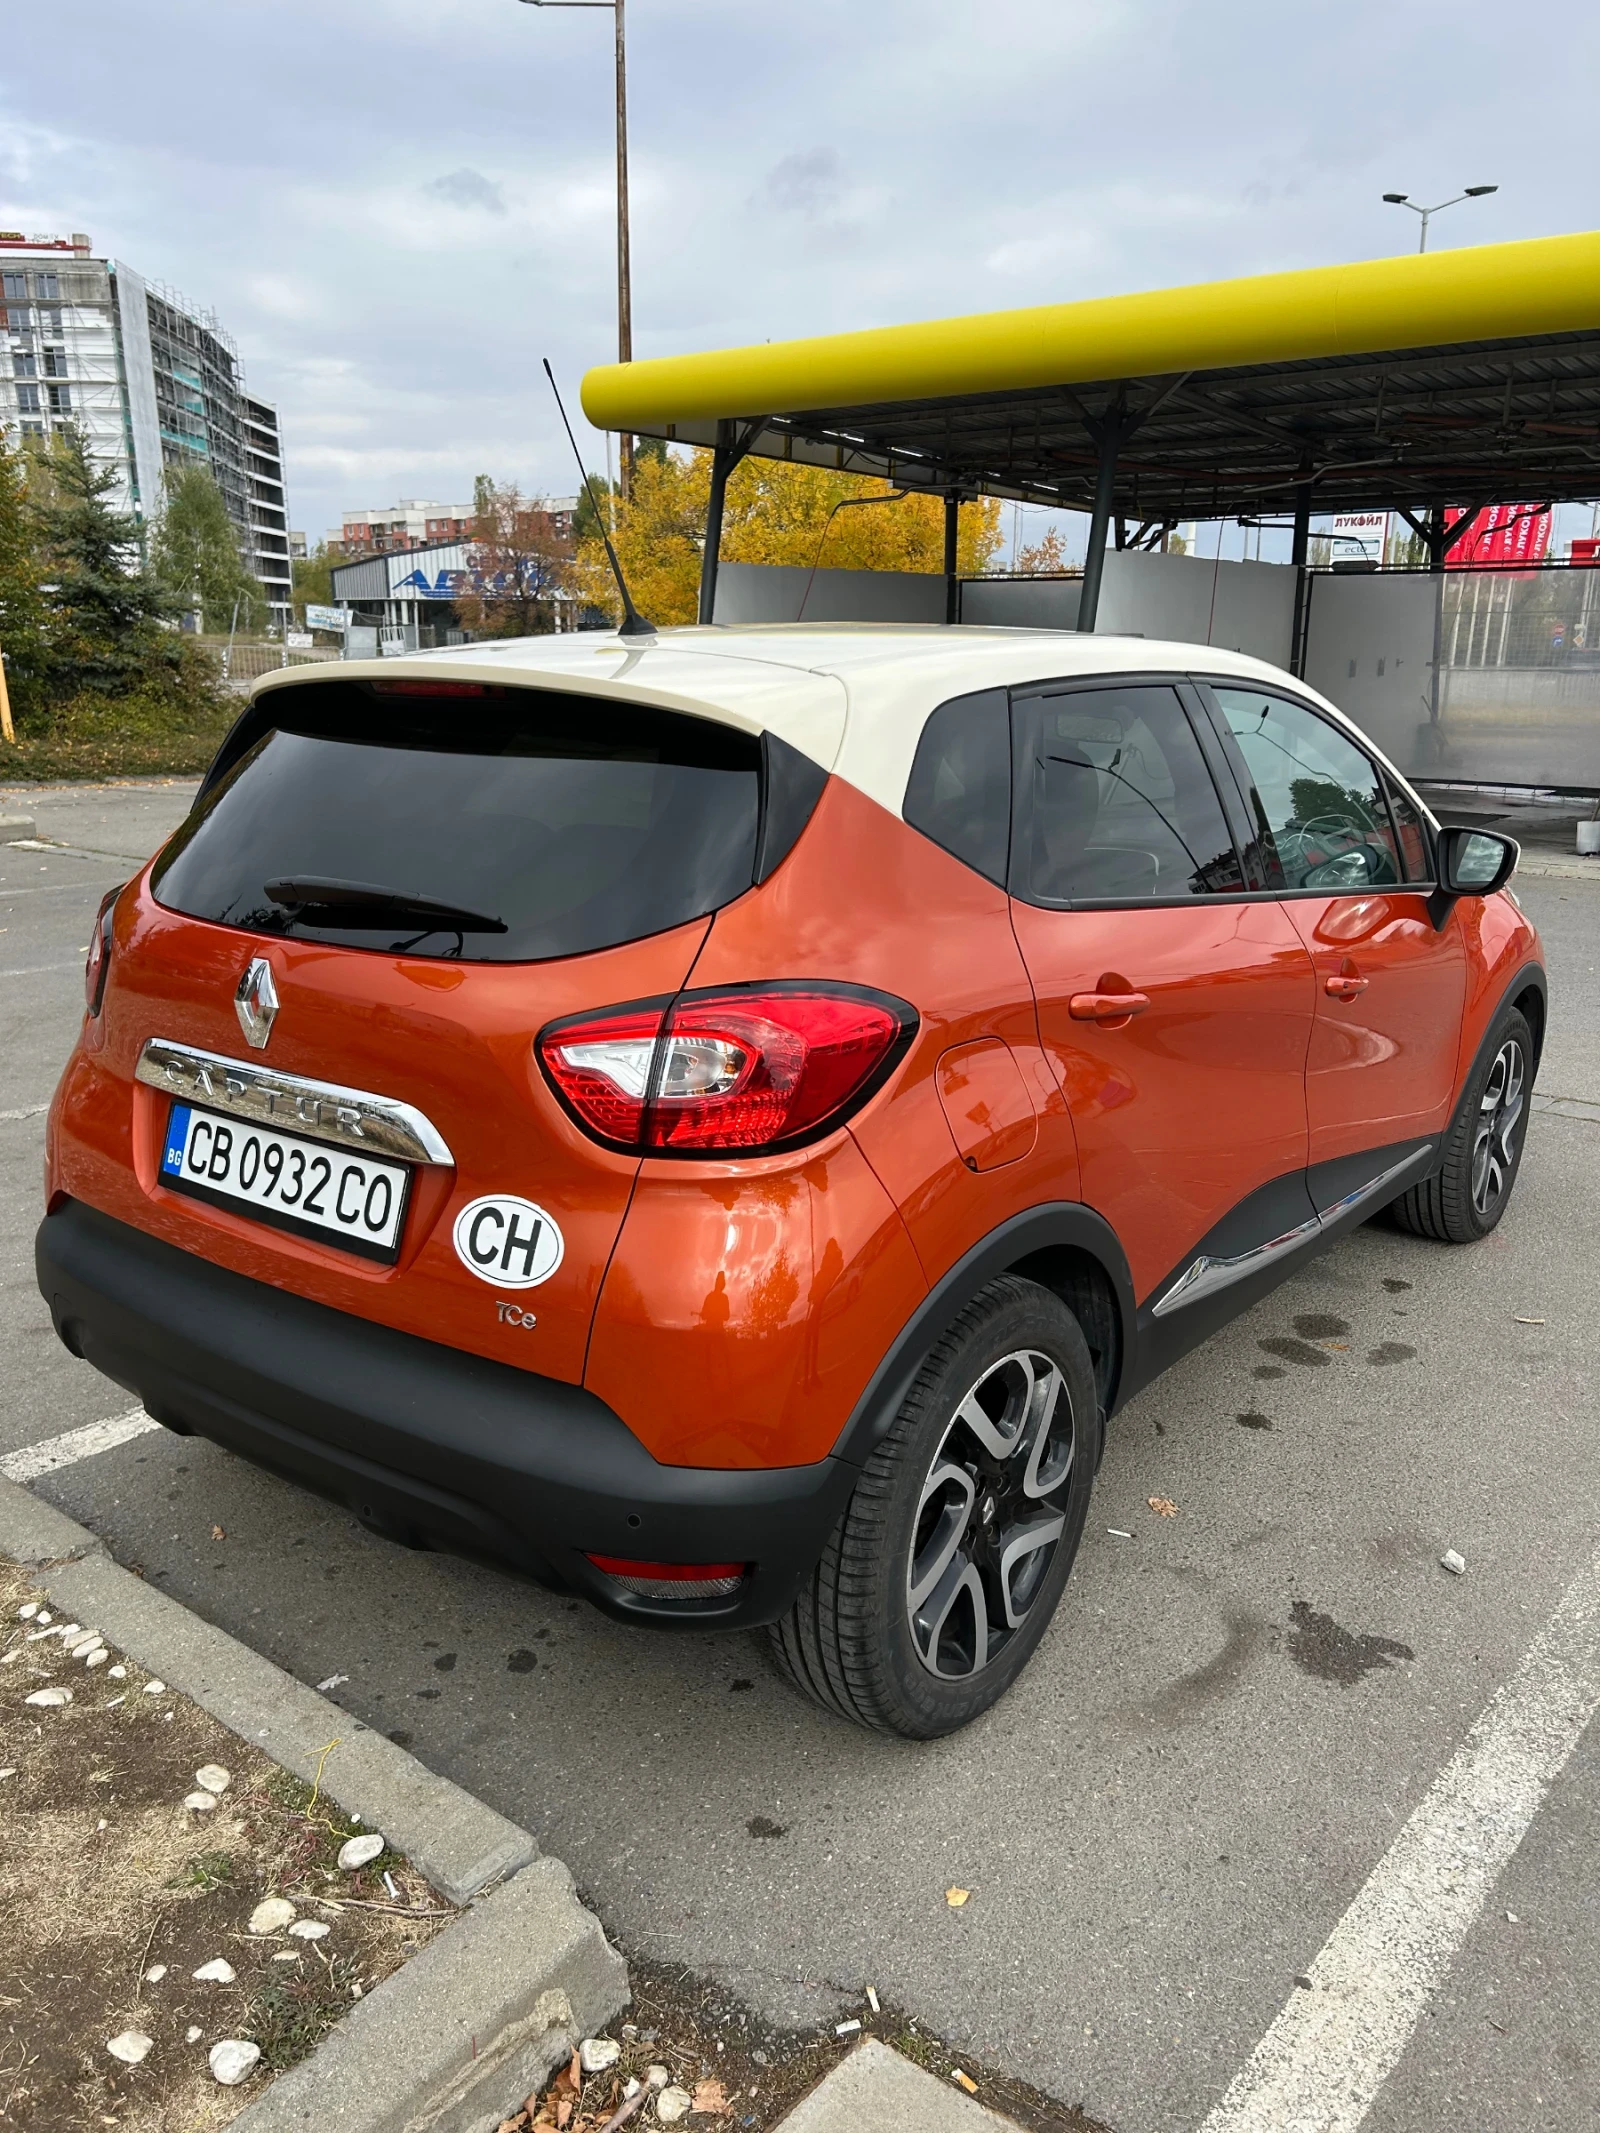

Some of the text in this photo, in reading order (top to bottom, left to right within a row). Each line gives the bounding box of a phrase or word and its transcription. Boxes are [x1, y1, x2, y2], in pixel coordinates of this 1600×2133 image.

[1334, 513, 1383, 528] ЛУКОЙЛ
[1344, 544, 1368, 554] ecto
[165, 1060, 365, 1138] CAPTUR
[167, 1147, 182, 1166] BG
[187, 1120, 233, 1182] CB
[239, 1136, 332, 1216] 0932
[469, 1206, 542, 1277] CH
[495, 1300, 537, 1330] TCe
